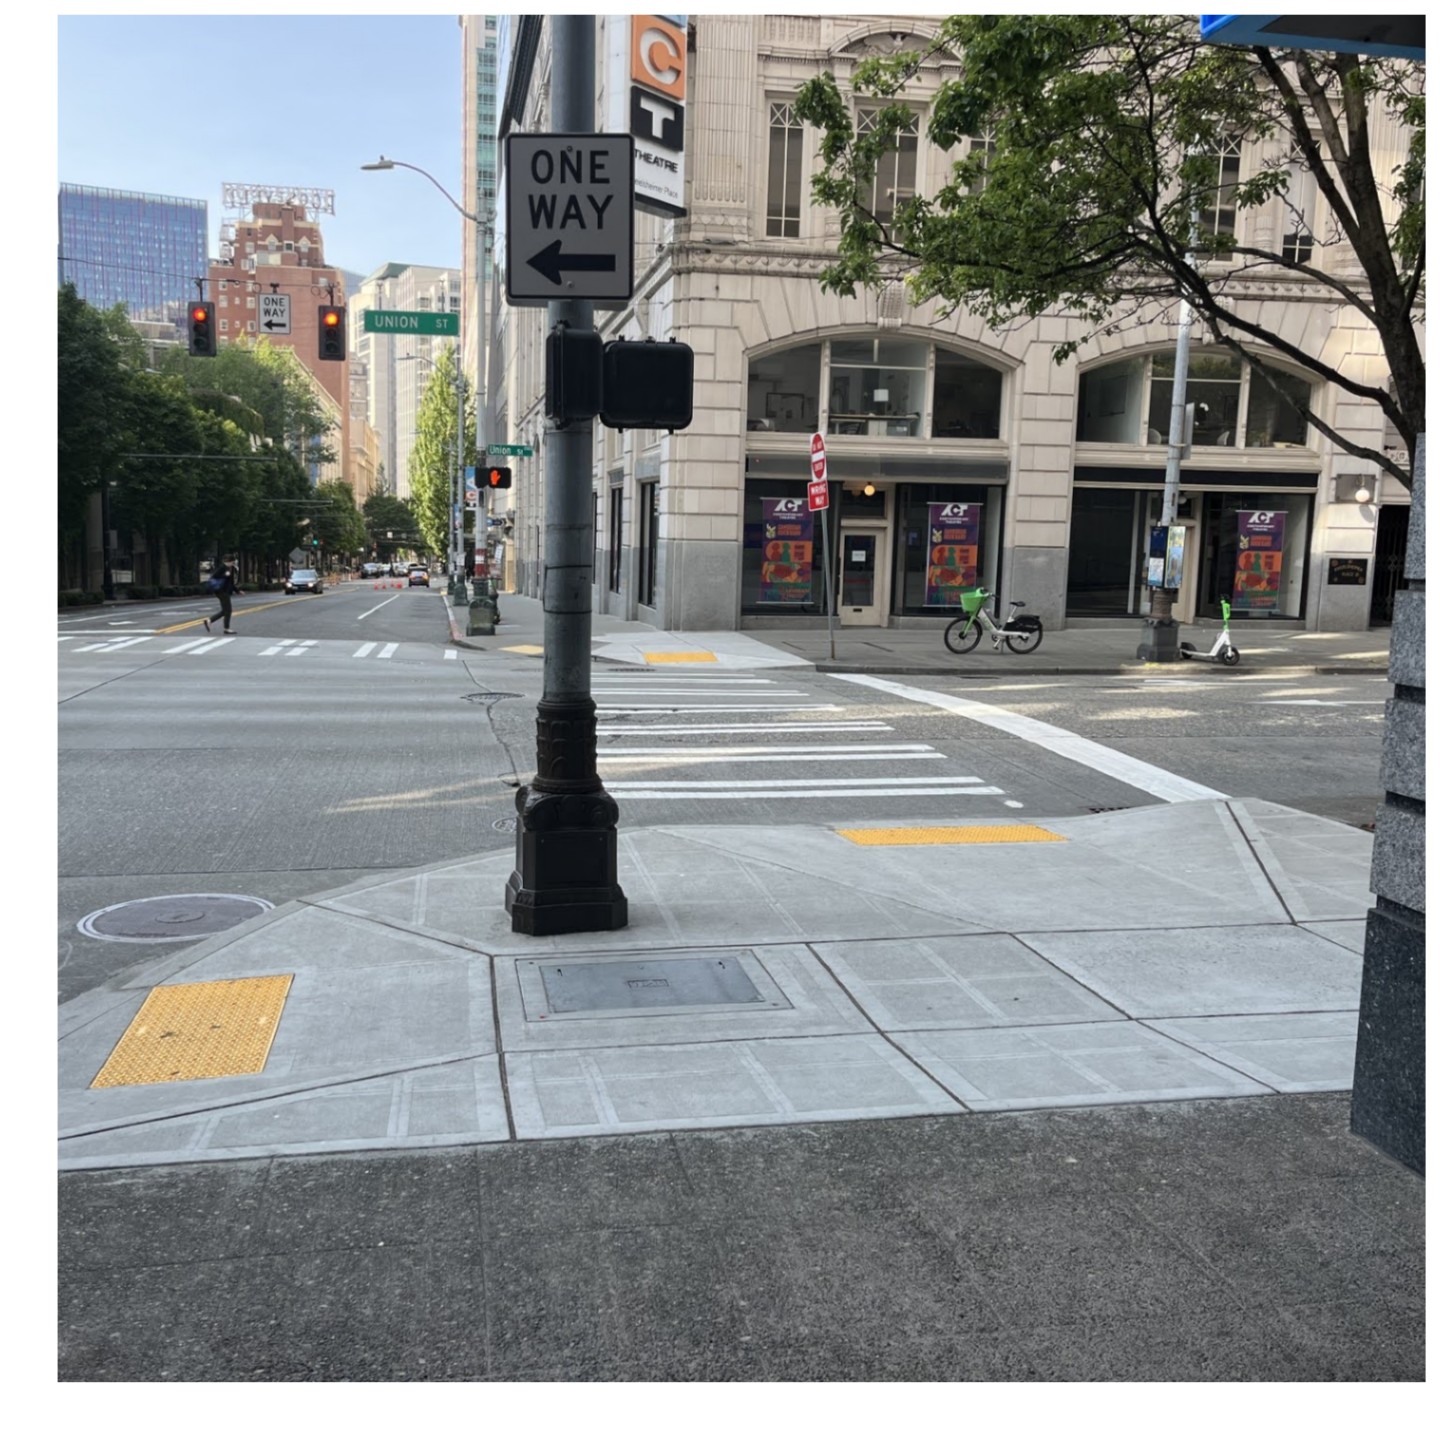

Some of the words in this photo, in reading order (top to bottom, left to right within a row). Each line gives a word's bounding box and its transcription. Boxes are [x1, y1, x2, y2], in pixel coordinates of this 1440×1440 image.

[531, 148, 611, 185] ONE
[634, 148, 679, 173] THEATRE
[528, 193, 614, 230] WAY
[263, 296, 286, 307] ONE
[263, 307, 286, 318] WAY
[374, 315, 418, 329] UNION
[435, 318, 449, 328] ST
[489, 445, 512, 455] Union
[774, 499, 803, 512] ACT
[940, 503, 968, 517] ACT
[1248, 512, 1275, 524] ACT
